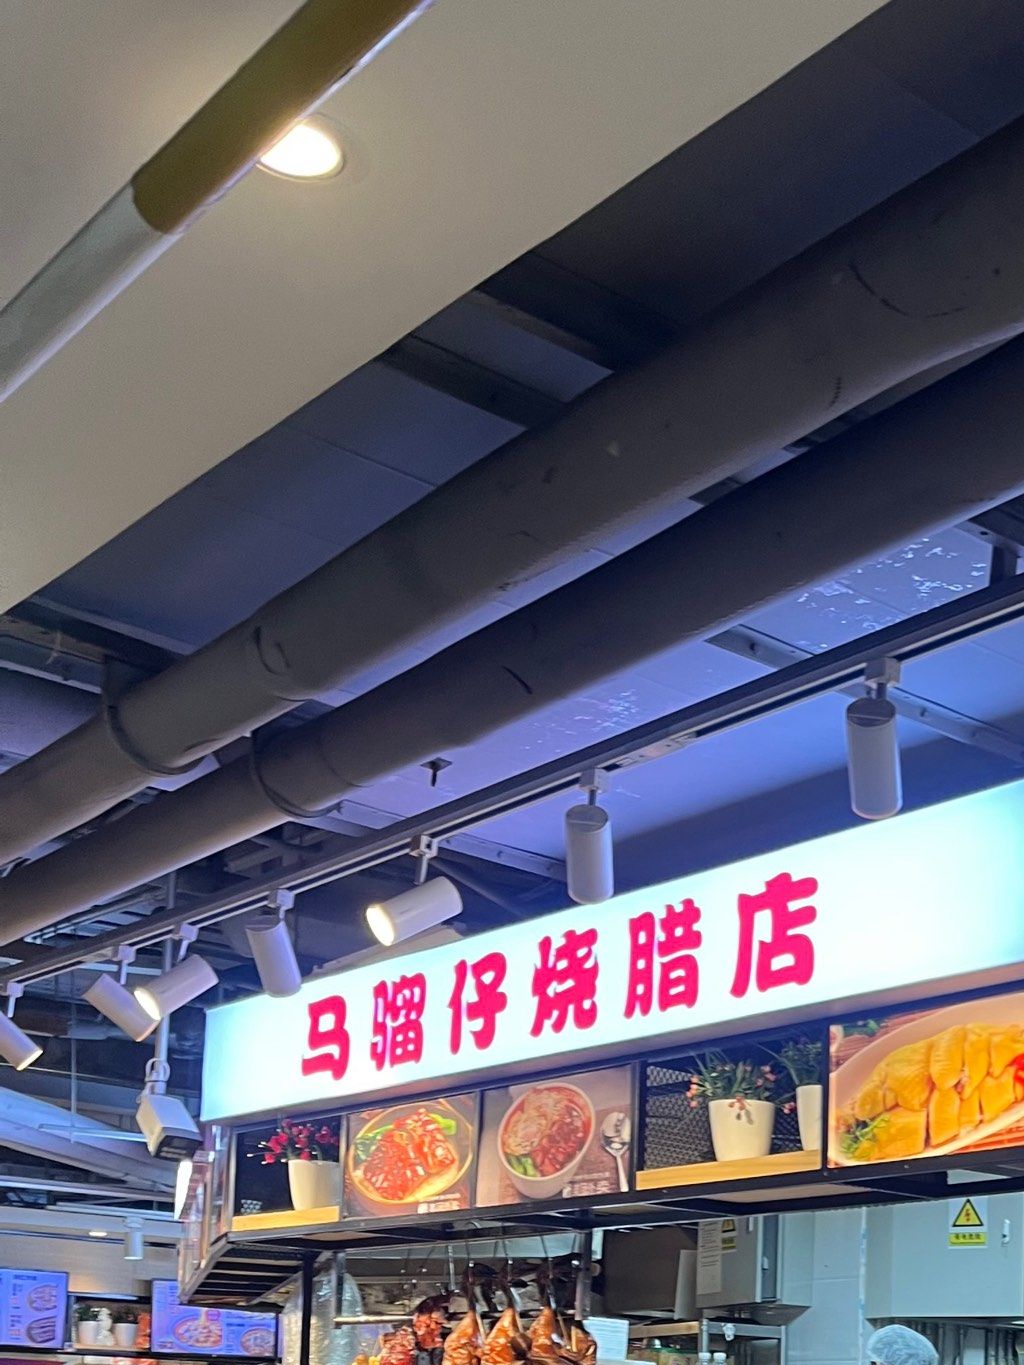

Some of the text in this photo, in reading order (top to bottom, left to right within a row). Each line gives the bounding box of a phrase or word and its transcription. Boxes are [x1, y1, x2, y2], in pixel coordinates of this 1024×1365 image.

[301, 871, 819, 1081] 马骝仔烧腊店
